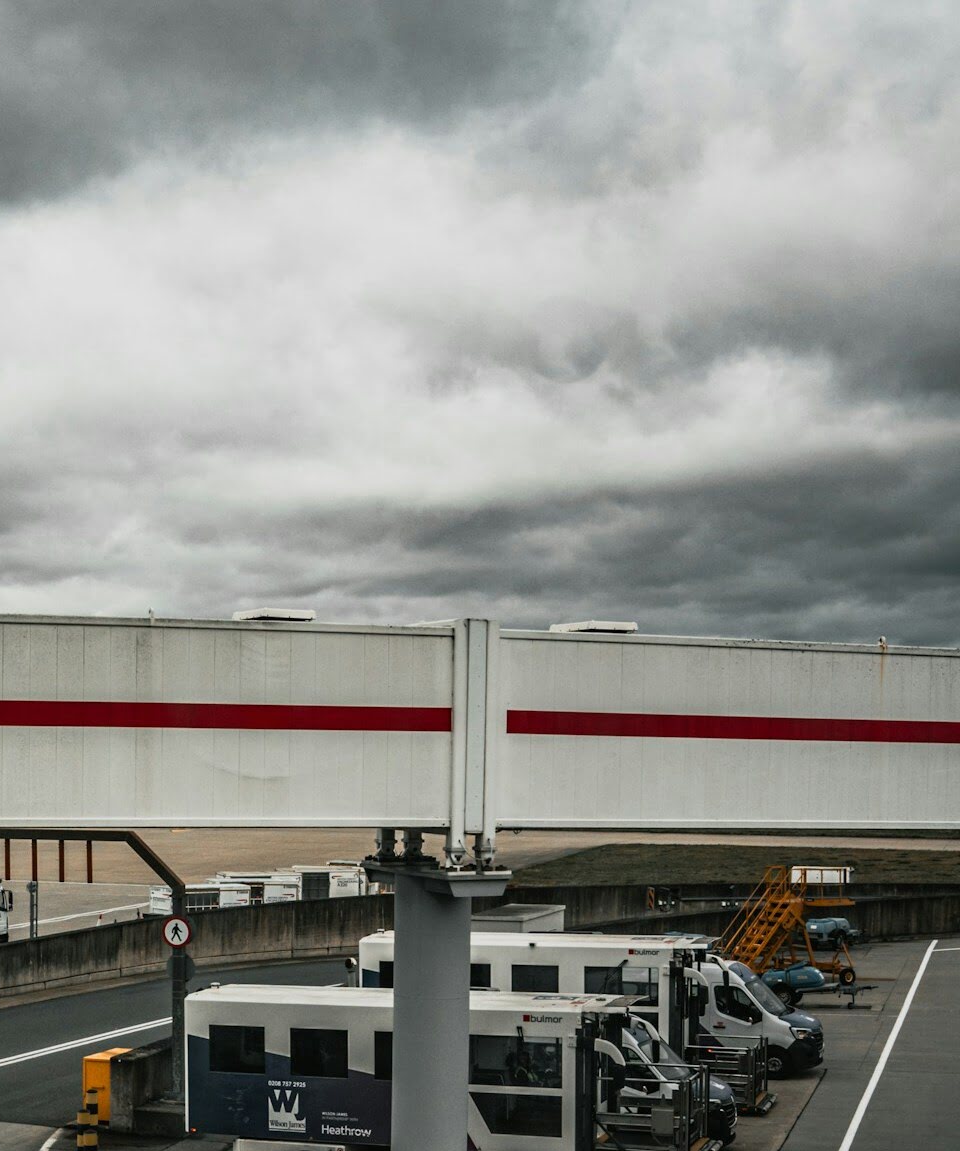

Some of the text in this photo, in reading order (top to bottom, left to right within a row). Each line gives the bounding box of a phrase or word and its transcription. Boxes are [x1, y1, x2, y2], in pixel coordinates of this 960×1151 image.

[530, 1014, 563, 1024] bulmor
[270, 1120, 306, 1130] Wilson James
[321, 1124, 372, 1138] Heathrow
